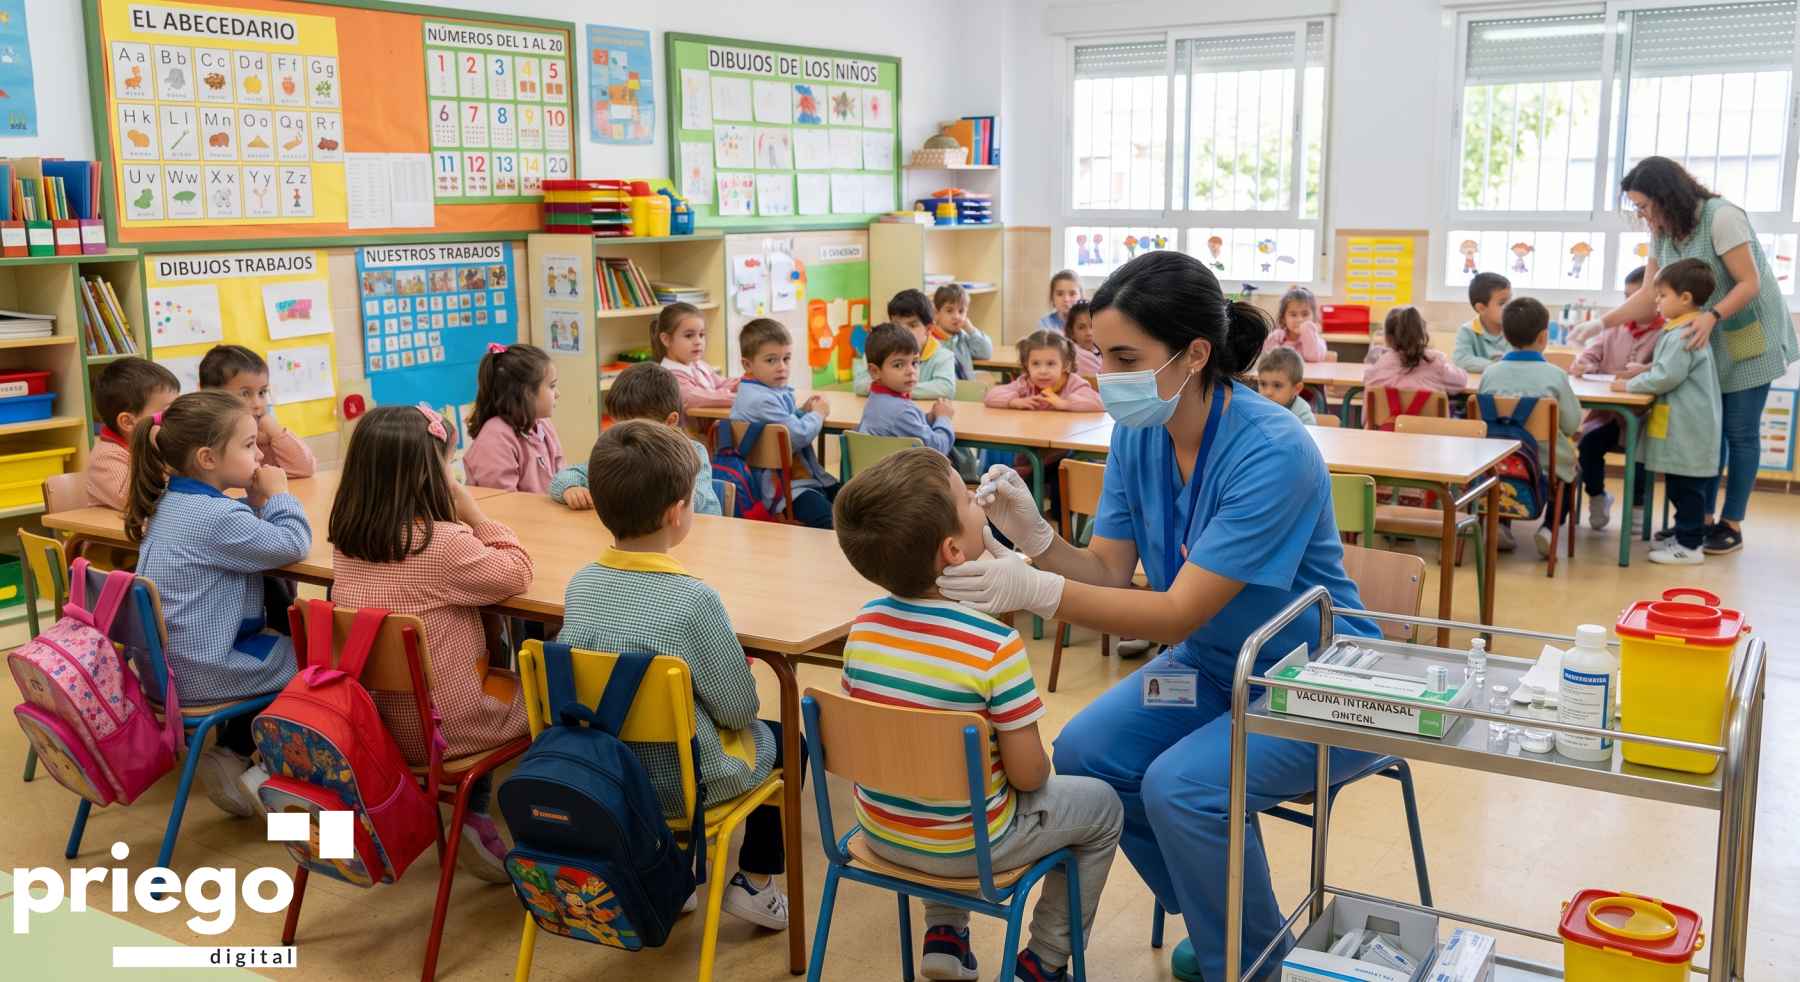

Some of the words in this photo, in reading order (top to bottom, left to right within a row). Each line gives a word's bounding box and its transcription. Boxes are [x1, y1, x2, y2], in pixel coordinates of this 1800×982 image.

[132, 10, 156, 28] EL
[163, 12, 294, 41] ABECEDARIO
[428, 26, 493, 46] NÚMEROS
[497, 34, 519, 48] DEL
[523, 37, 529, 48] 1
[532, 38, 546, 50] AL
[550, 40, 563, 52] 20
[439, 55, 445, 72] 1
[466, 56, 477, 73] 2
[495, 59, 505, 75] 3
[522, 62, 532, 77] 4
[550, 63, 558, 78] 5
[709, 50, 773, 73] DIBUJOS
[779, 58, 798, 75] DE
[804, 59, 831, 78] LOS
[836, 61, 877, 83] NIÑOS
[440, 105, 449, 121] 6
[469, 106, 478, 123] 7
[498, 108, 507, 124] 8
[547, 110, 565, 127] 10
[440, 156, 454, 173] 11
[468, 156, 485, 173] 12
[496, 156, 513, 173] 13
[524, 157, 539, 172] 14
[550, 157, 567, 173] 20
[366, 248, 436, 263] NUESTROS
[439, 245, 501, 260] TRABAJOS
[159, 260, 231, 278] DIBUJOS
[234, 256, 312, 272] TRABAJOS
[1296, 690, 1340, 705] VACUNA
[1344, 698, 1413, 717] INTRANASAL
